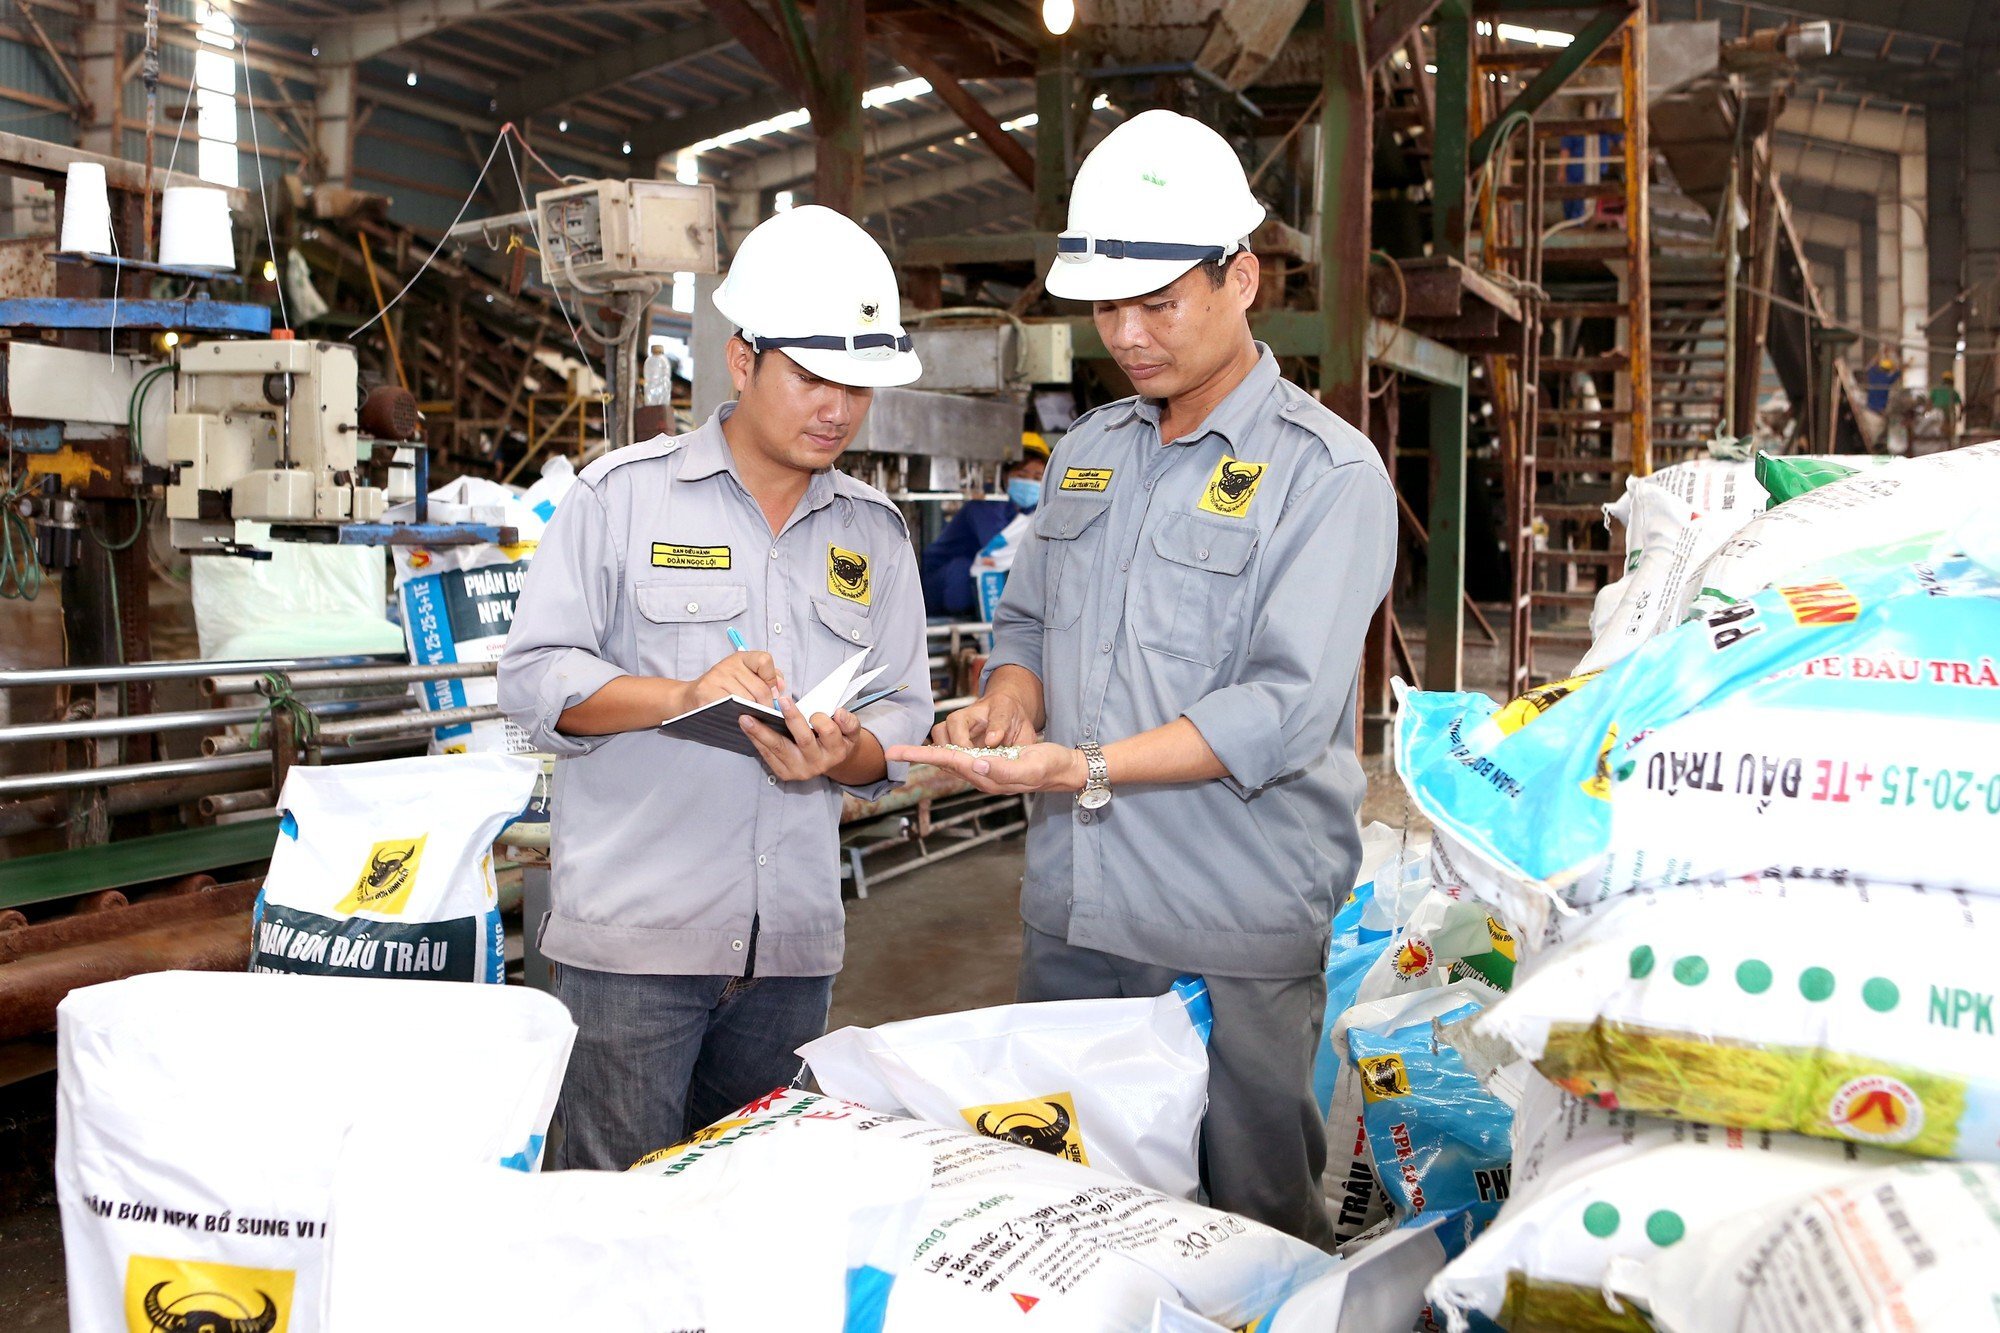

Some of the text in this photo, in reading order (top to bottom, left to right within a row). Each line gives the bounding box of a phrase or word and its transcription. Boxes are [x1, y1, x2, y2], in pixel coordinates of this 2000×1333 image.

[463, 566, 528, 598] PHÂN BÓ
[477, 599, 513, 624] NPK
[1928, 658, 2000, 687] TRÂ
[1647, 750, 1724, 797] TRÂU
[1735, 751, 1802, 815] ĐẦU
[1879, 764, 2000, 815] 0-20-15
[258, 917, 448, 973] HÂN BÓN ĐẦU TRÂU
[1928, 983, 1995, 1036] NPK
[1389, 1122, 1415, 1163] NPK
[1337, 1161, 1375, 1227] TRÂU
[117, 1200, 158, 1223] BÓN
[162, 1209, 199, 1231] NPK
[203, 1209, 232, 1233] BỔ
[235, 1217, 290, 1238] SUNG
[295, 1220, 315, 1239] VI
[950, 1251, 977, 1272] Bón
[971, 1230, 999, 1253] thúc
[968, 1258, 996, 1279] Bón
[988, 1239, 1017, 1260] thúc
